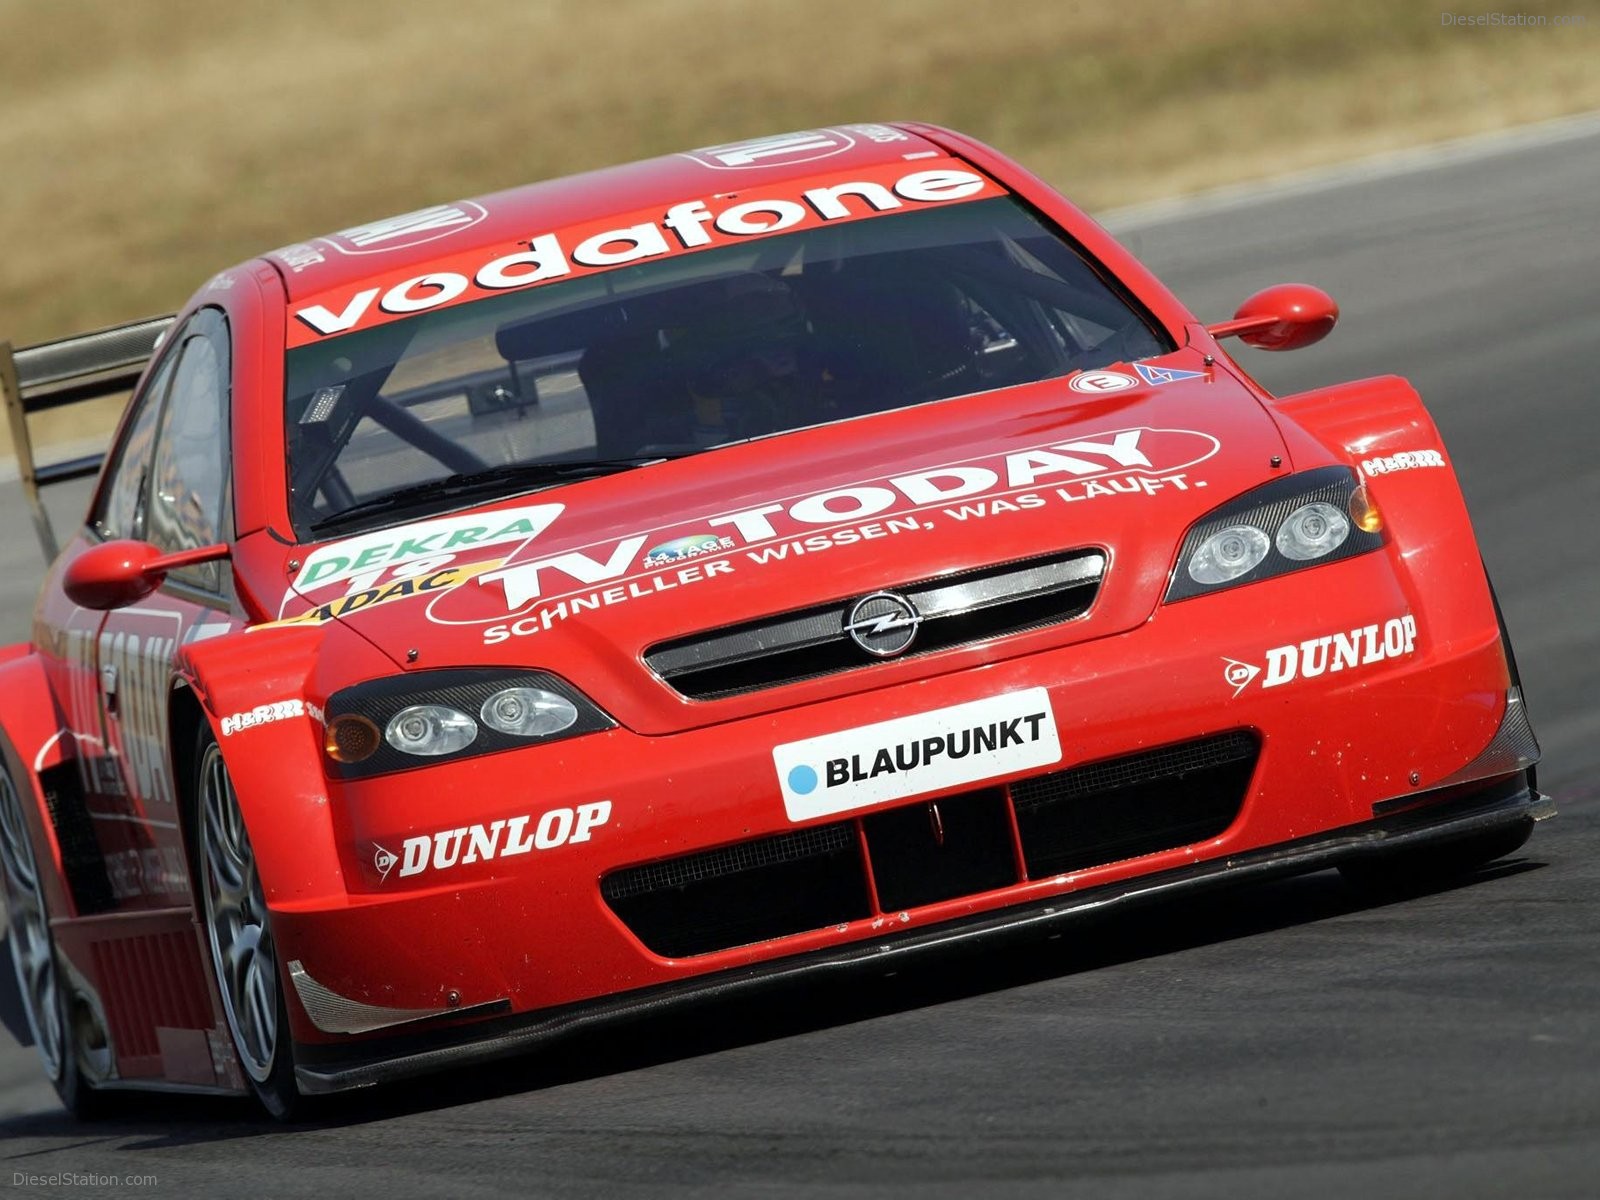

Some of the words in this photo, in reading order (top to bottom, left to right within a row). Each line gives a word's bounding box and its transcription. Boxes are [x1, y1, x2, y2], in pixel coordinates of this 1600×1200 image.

[296, 169, 985, 335] vodafone
[1087, 377, 1123, 390] E
[298, 518, 534, 588] DEKRA
[478, 534, 651, 611] TV
[709, 429, 1154, 543] TODAY
[292, 568, 460, 622] ADAC
[483, 560, 735, 644] SCHNELLER
[747, 512, 934, 566] WISSEN,
[943, 494, 1046, 521] WAS
[1057, 473, 1207, 502] LÄUFT.
[1262, 614, 1417, 688] DUNLOP
[826, 712, 1046, 788] BLAUPUNKT
[400, 800, 612, 877] DUNLOP
